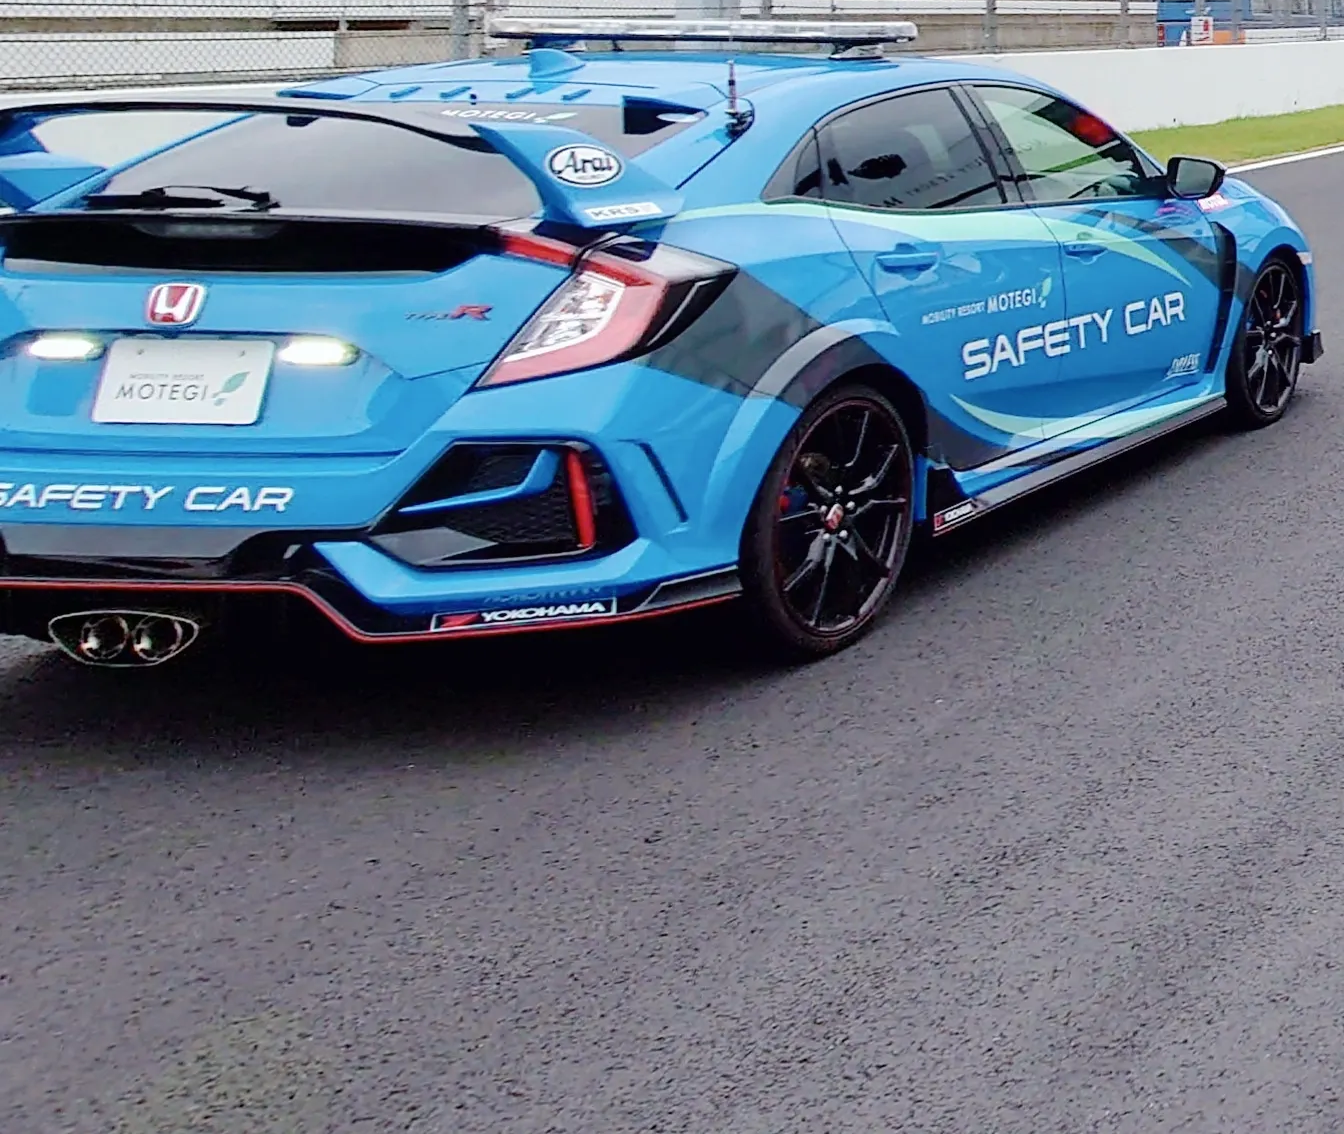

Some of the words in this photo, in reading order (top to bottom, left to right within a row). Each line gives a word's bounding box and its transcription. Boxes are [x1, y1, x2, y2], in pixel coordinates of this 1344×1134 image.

[554, 150, 613, 174] Arai
[987, 288, 1036, 314] MOTEGI
[962, 308, 1113, 381] SAFETY
[1124, 291, 1186, 336] CAR
[115, 383, 209, 401] MOTEGI
[184, 486, 294, 512] CAR
[481, 602, 606, 622] YOKOHAMA
